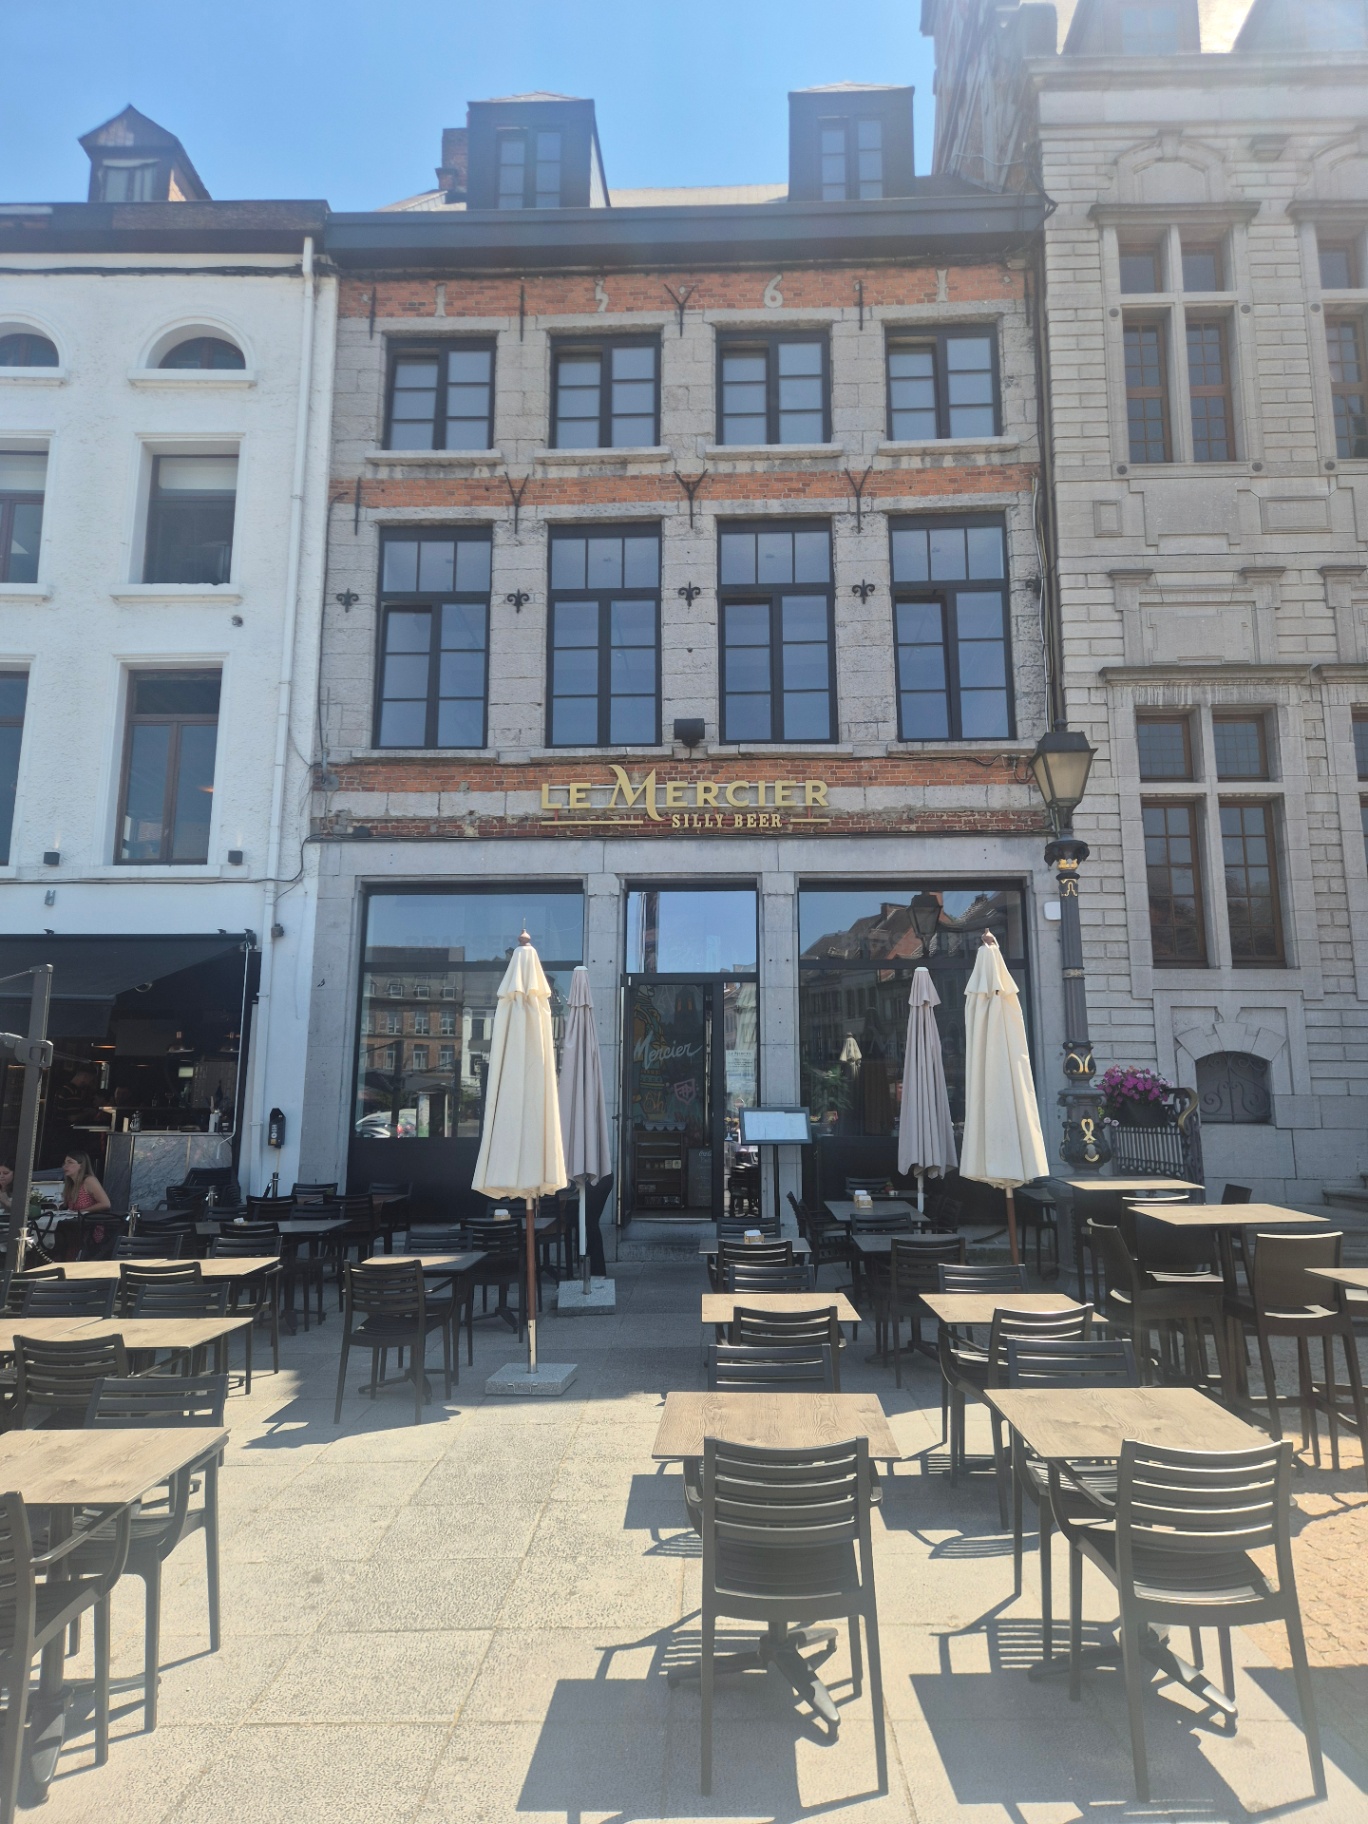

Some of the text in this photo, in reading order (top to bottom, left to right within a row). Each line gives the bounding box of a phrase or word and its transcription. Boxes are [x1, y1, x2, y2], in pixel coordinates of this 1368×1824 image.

[764, 273, 784, 308] 6
[541, 782, 592, 810] LE
[671, 813, 783, 828] SILLY BEER
[633, 1029, 703, 1070] Mercier
